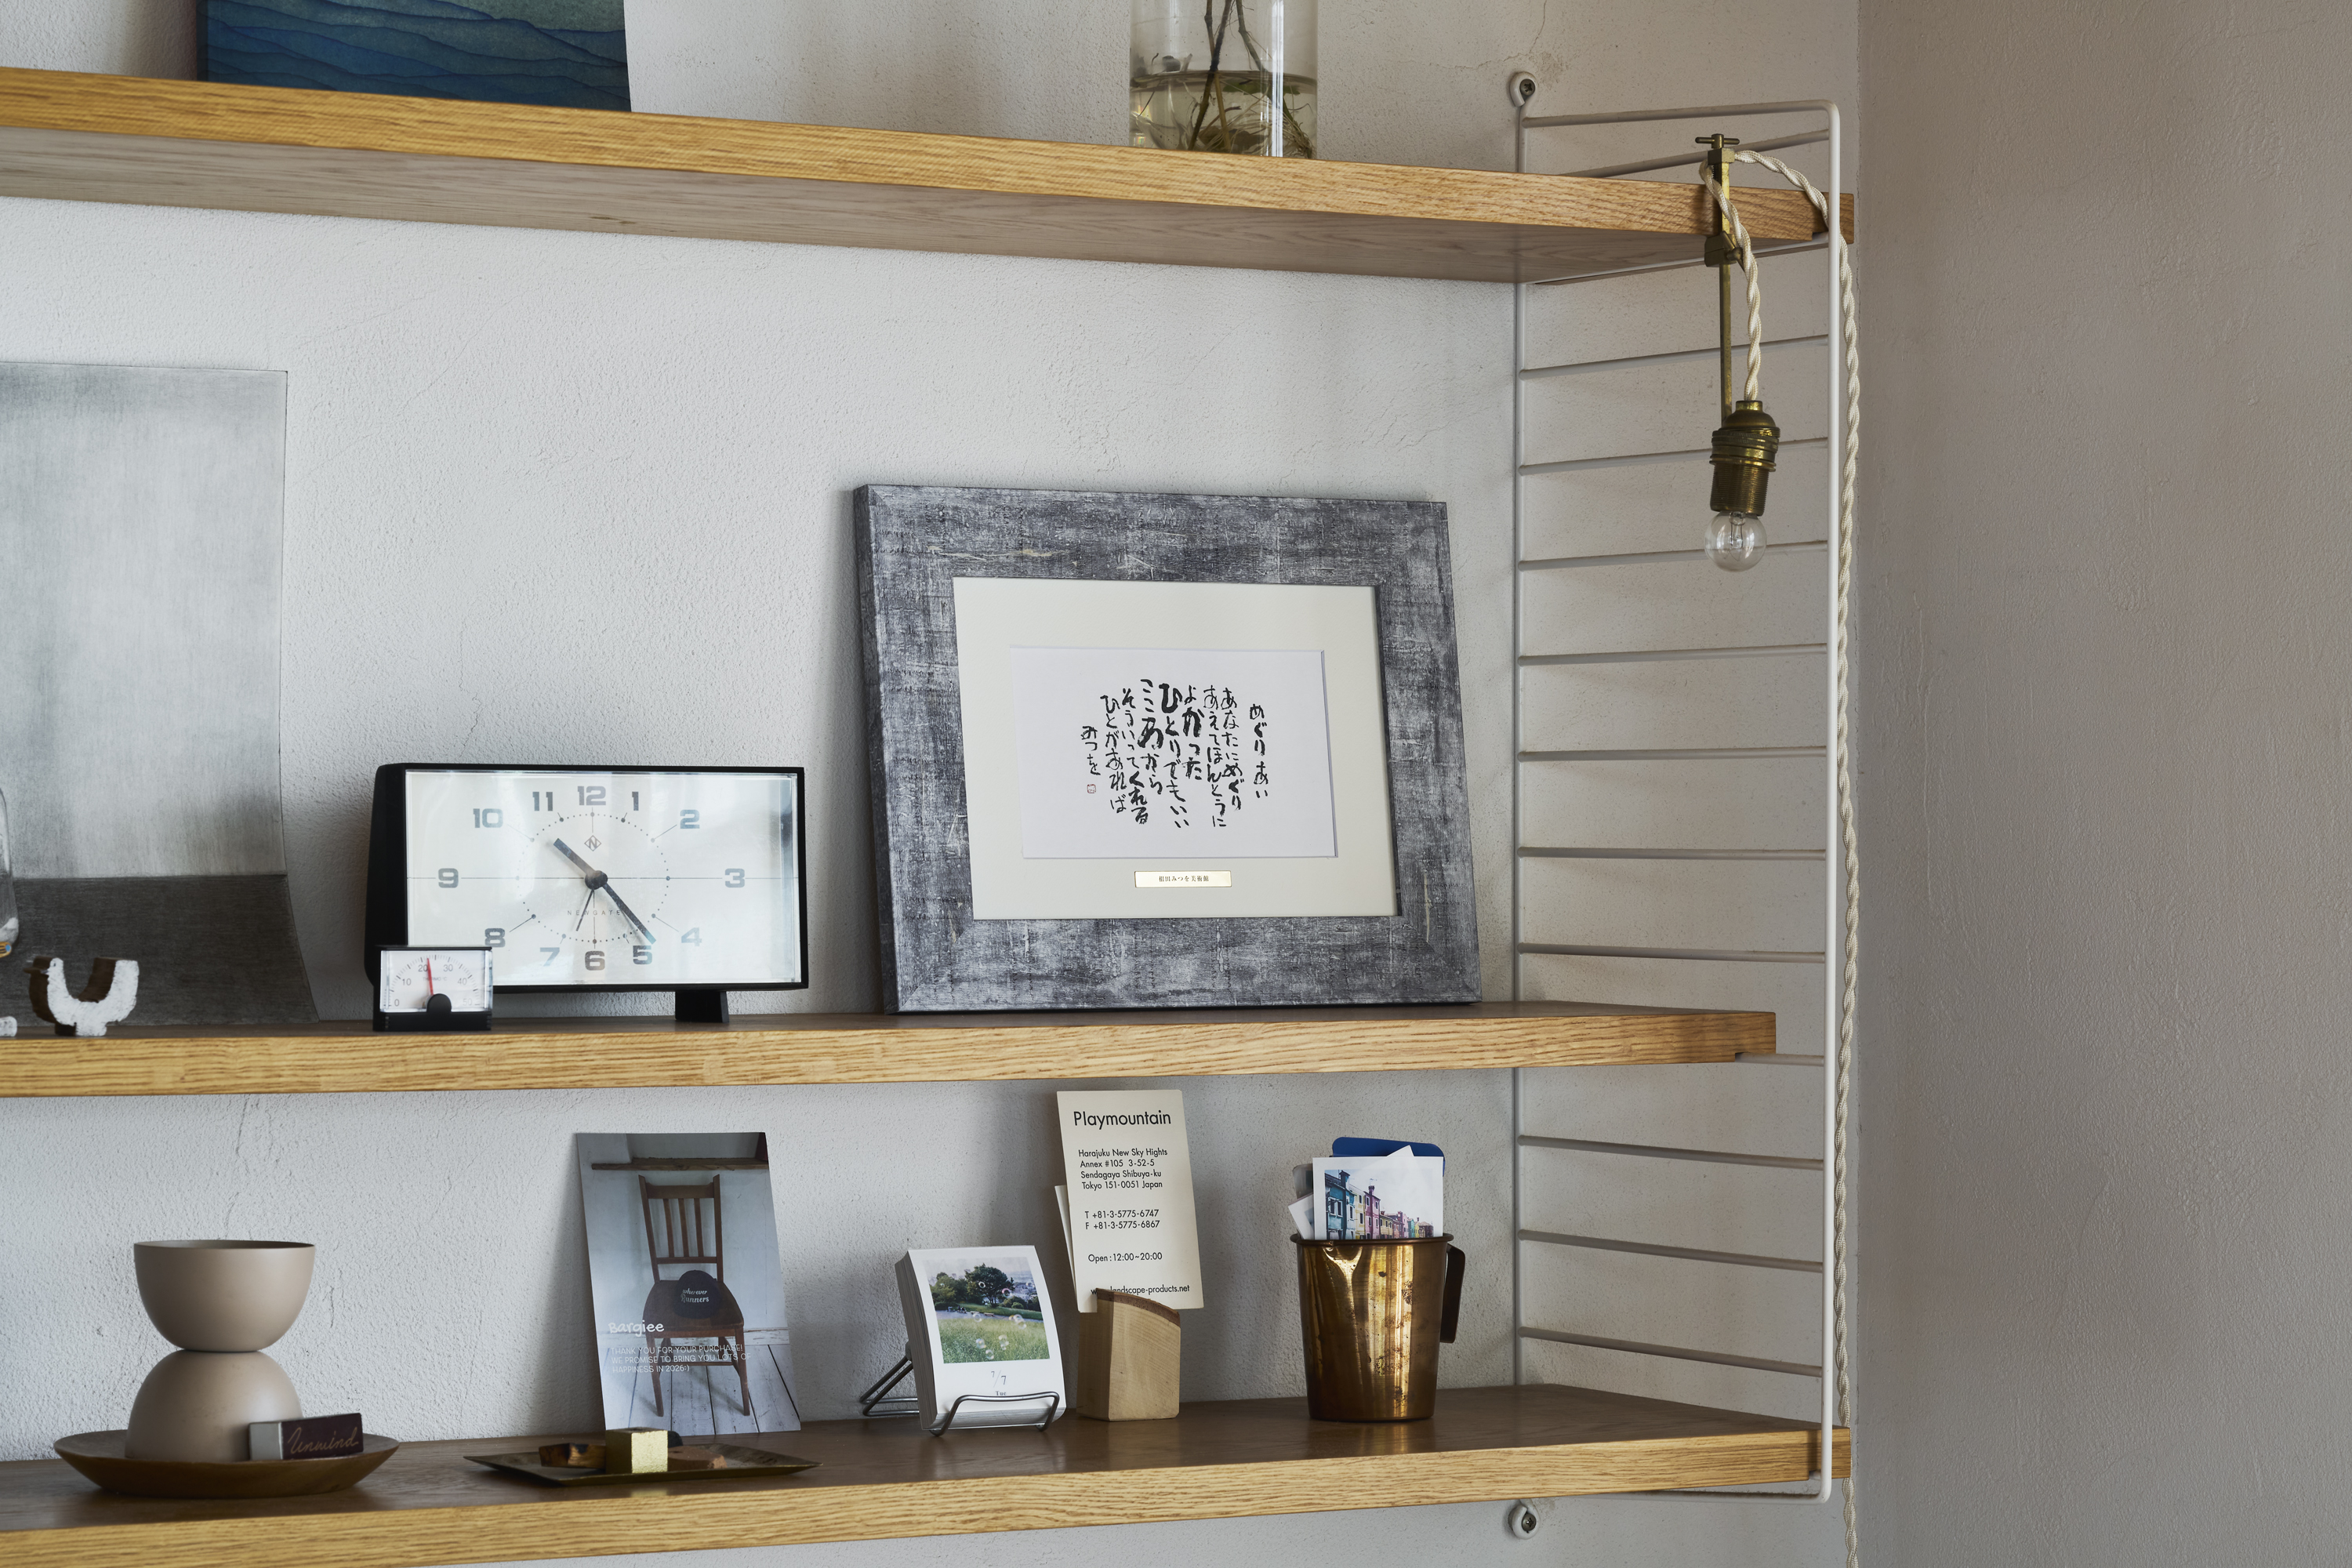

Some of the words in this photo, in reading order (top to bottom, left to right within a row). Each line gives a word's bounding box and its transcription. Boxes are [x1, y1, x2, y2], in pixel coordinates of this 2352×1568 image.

[1181, 684, 1205, 781] よかった
[1080, 725, 1102, 776] みつを
[1099, 695, 1127, 814] ひとがあれば
[1158, 683, 1189, 828] ひとりでもいい
[1203, 684, 1227, 827] あえてほんとうに
[1220, 687, 1245, 811] あなたにめぐり
[1249, 703, 1269, 799] めぐりあい
[532, 791, 554, 811] 11
[578, 786, 606, 806] 12
[631, 791, 639, 811] 1
[473, 808, 503, 829] 10
[680, 809, 700, 829] 2
[437, 868, 459, 888] 9
[724, 868, 746, 888] 3
[485, 927, 506, 948] 8
[681, 927, 702, 946] 4
[539, 946, 561, 967] 7
[584, 950, 605, 971] 6
[632, 945, 653, 965] 5
[1073, 1109, 1171, 1131] Playmountain
[1078, 1149, 1110, 1159] Harajuku
[1131, 1148, 1144, 1159] Sky
[1145, 1147, 1168, 1158] Hights
[1128, 1158, 1155, 1167] 3-52-5
[1080, 1171, 1120, 1181] Sendagaya
[1122, 1170, 1162, 1180] Shibuya-ku
[1081, 1181, 1102, 1192] Tokyo
[1105, 1180, 1139, 1189] 151-0051
[1142, 1180, 1163, 1190] Japan
[1084, 1210, 1090, 1219] T
[1092, 1209, 1160, 1218] +81-3-5775-6747
[1085, 1221, 1090, 1230] F
[1093, 1220, 1160, 1229] +81-3-5775-6867
[680, 1294, 710, 1304] Runners
[1091, 1284, 1190, 1296] wlndscape-products.net
[608, 1319, 665, 1338] Bargiee
[699, 1344, 743, 1352] PURCHASE!
[288, 1427, 358, 1454] Unwind
